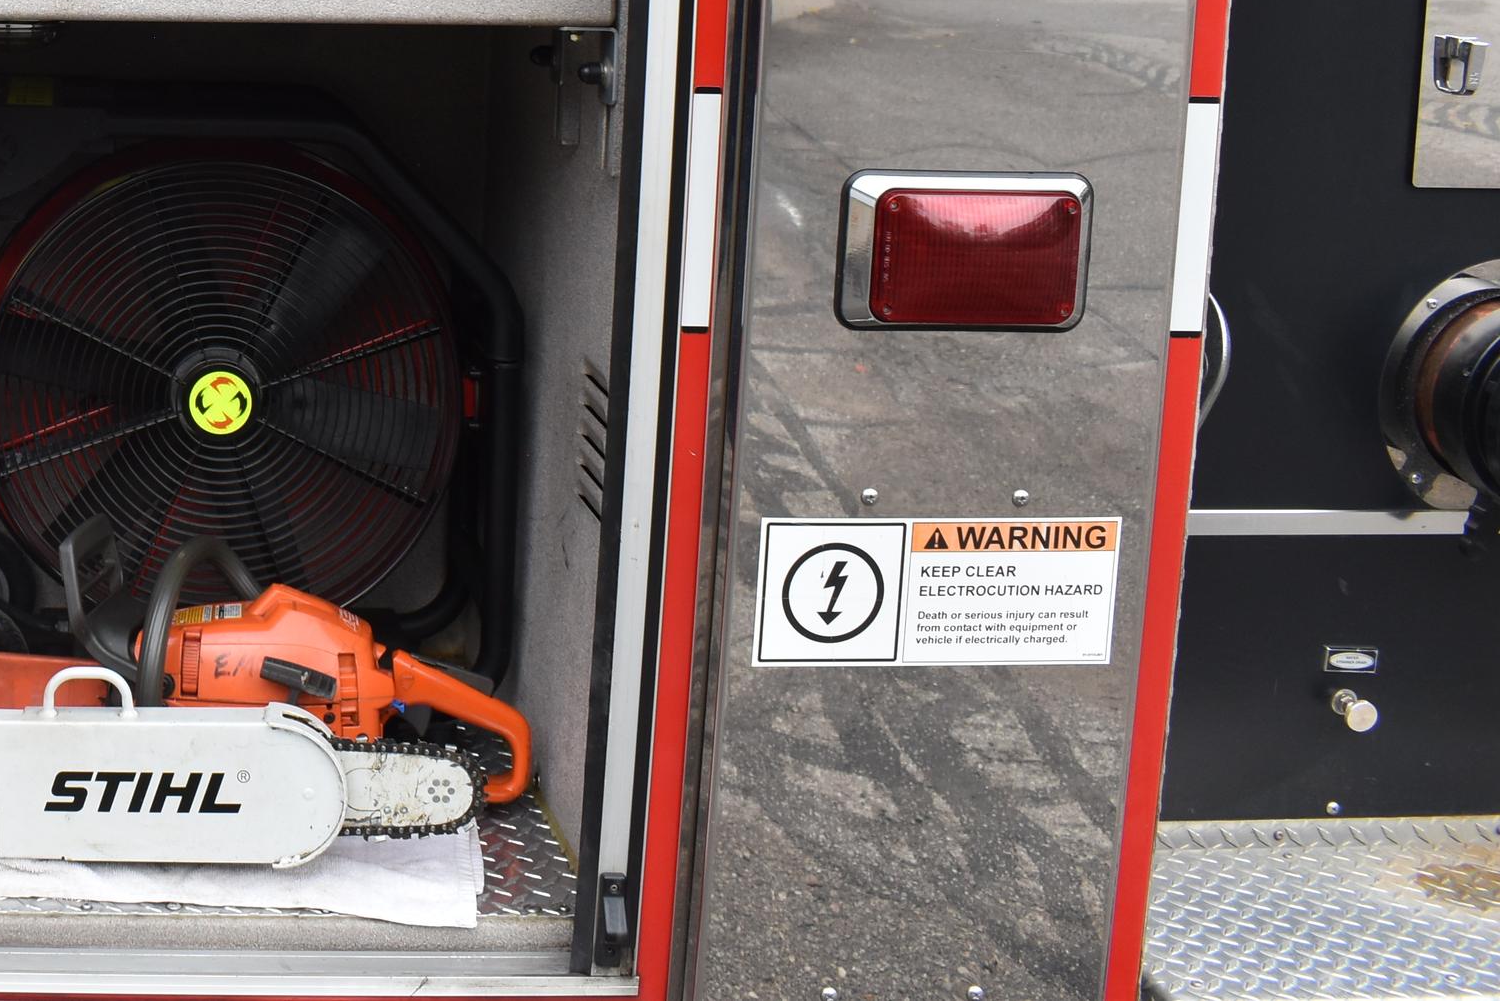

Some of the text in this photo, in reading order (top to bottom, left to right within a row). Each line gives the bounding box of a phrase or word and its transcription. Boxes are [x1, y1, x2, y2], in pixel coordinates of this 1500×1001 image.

[956, 525, 1107, 550] WARNING
[920, 565, 1017, 577] KEEP CLEAR
[919, 584, 1103, 597] ELECTROCUTION HAZARD
[917, 611, 947, 620] Death
[964, 611, 1003, 620] serious
[1006, 610, 1034, 621] injury
[1059, 610, 1089, 619] result
[917, 623, 940, 632] from
[943, 624, 982, 632] contact
[985, 623, 1006, 631] with
[1009, 623, 1063, 633] equipment
[916, 635, 1068, 645] vehicle if electrically charged.
[43, 771, 242, 814] STIHL
